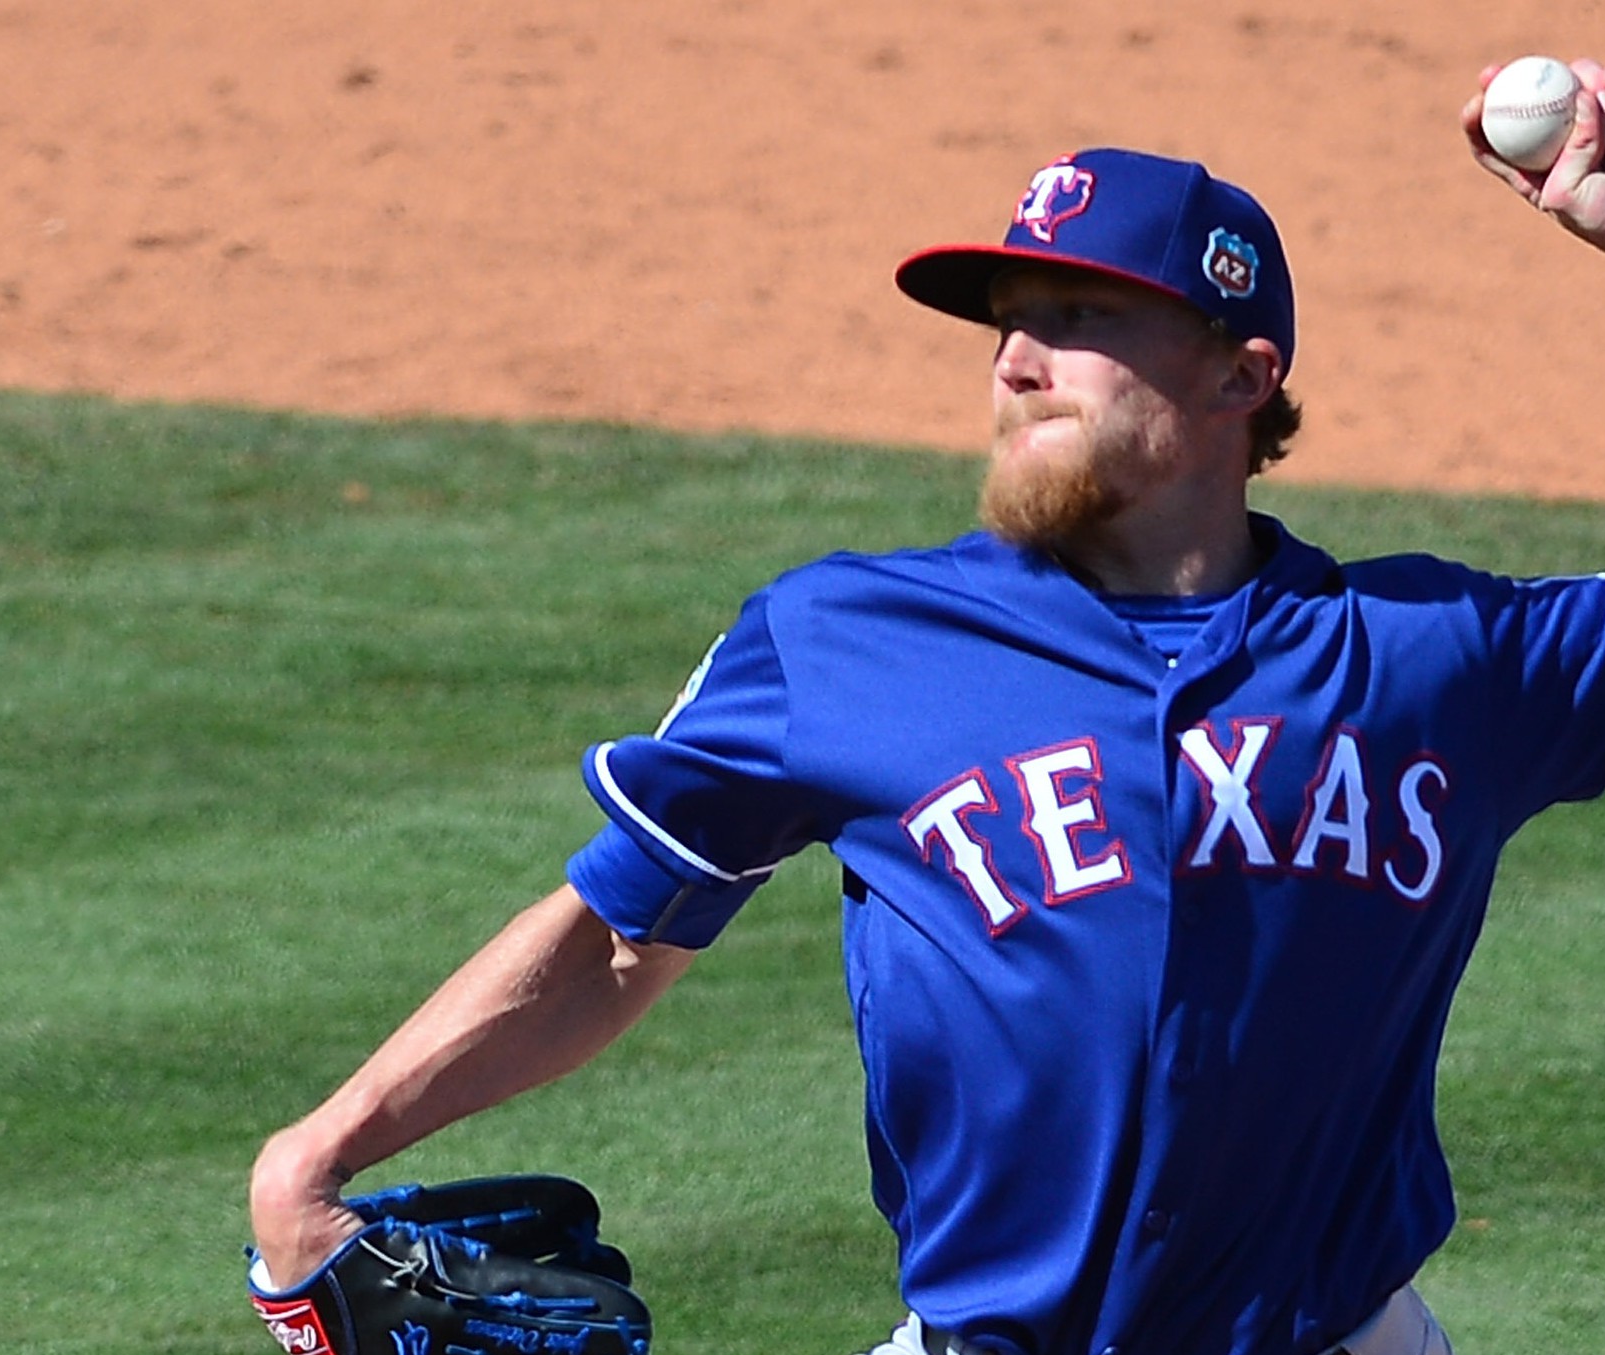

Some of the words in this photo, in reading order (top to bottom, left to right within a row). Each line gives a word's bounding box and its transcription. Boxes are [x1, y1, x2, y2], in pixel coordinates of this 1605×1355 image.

[1022, 164, 1077, 221] T
[1213, 254, 1247, 288] AZ
[901, 716, 1450, 936] TEXAS
